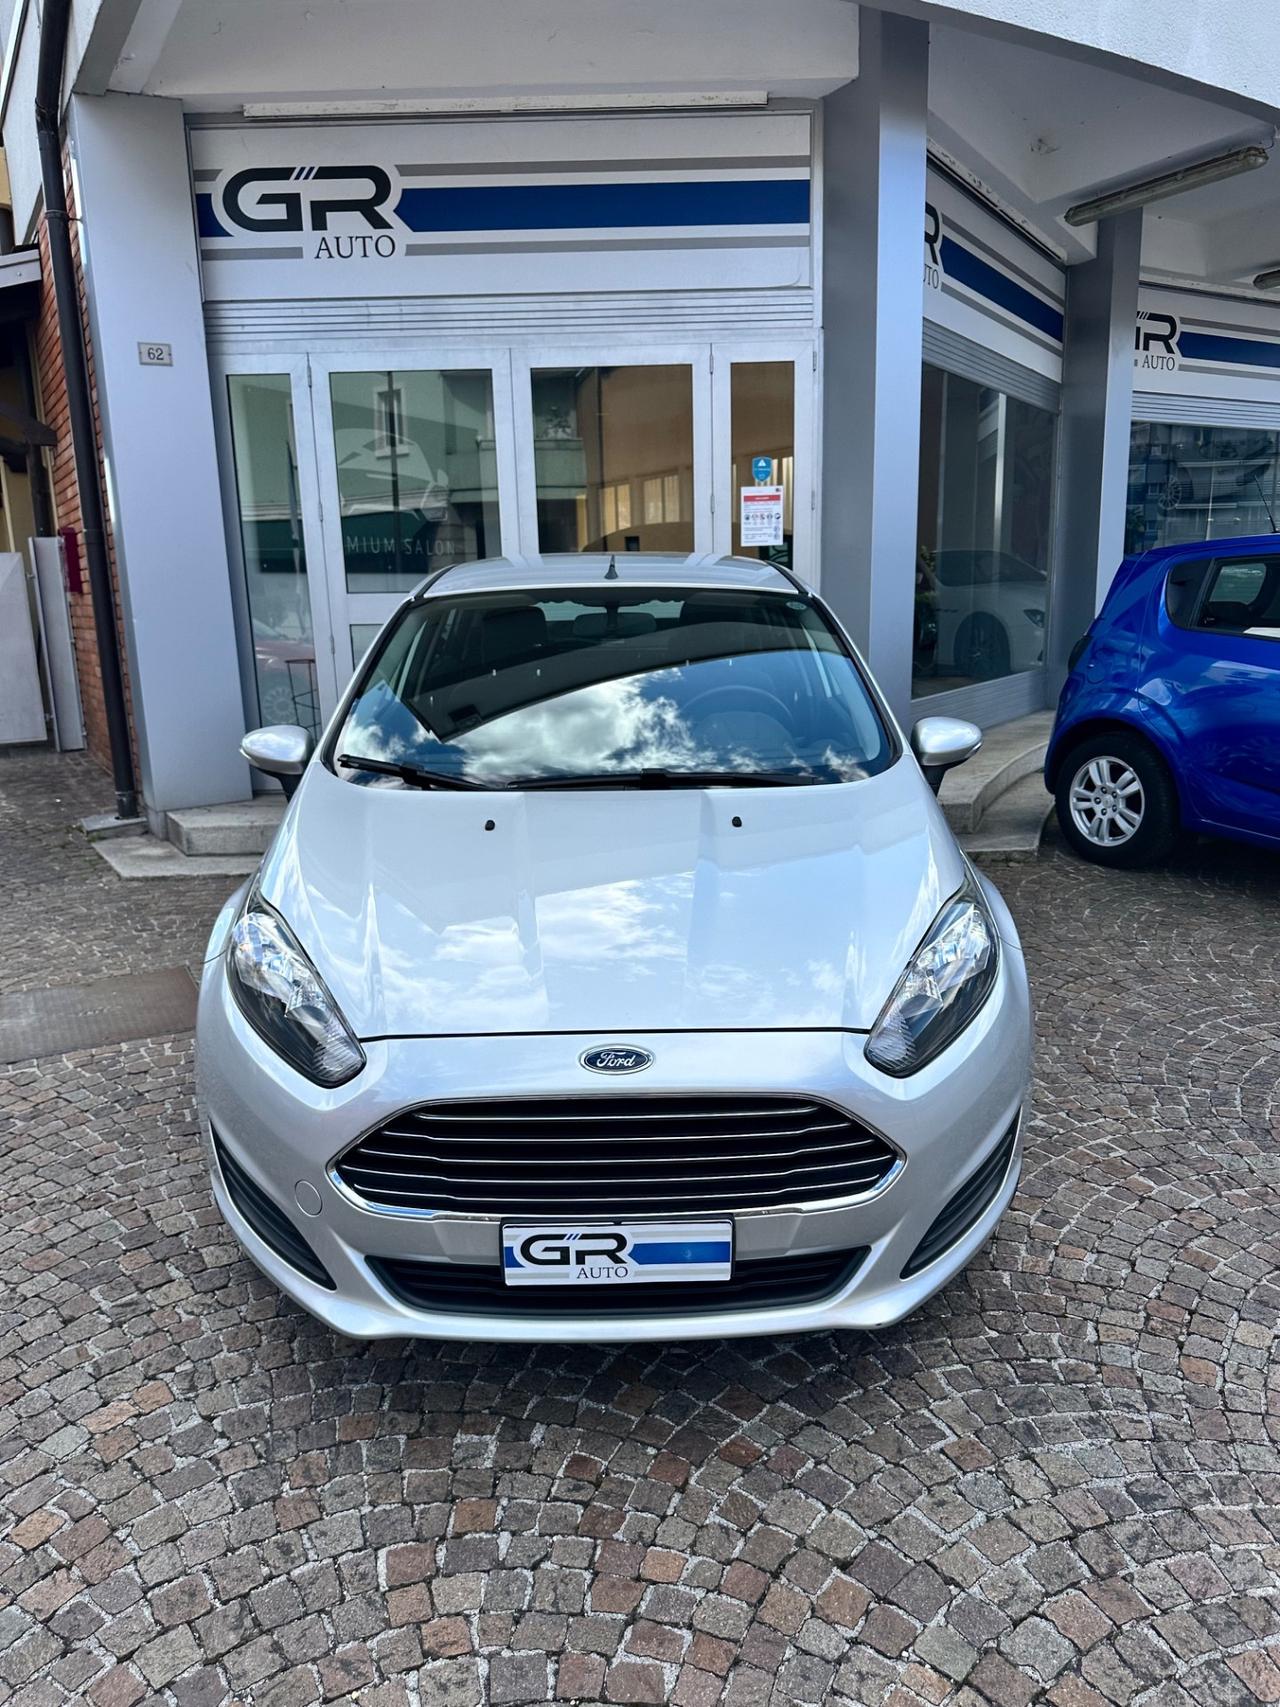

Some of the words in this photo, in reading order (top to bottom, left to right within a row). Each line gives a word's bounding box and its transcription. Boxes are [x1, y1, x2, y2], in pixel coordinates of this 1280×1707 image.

[222, 165, 395, 232] GR
[314, 234, 396, 260] AUTO
[147, 347, 164, 360] 62
[1142, 354, 1175, 371] AUTO
[596, 1051, 636, 1067] Ford
[520, 1232, 628, 1265] GR
[576, 1266, 629, 1279] AUTO
